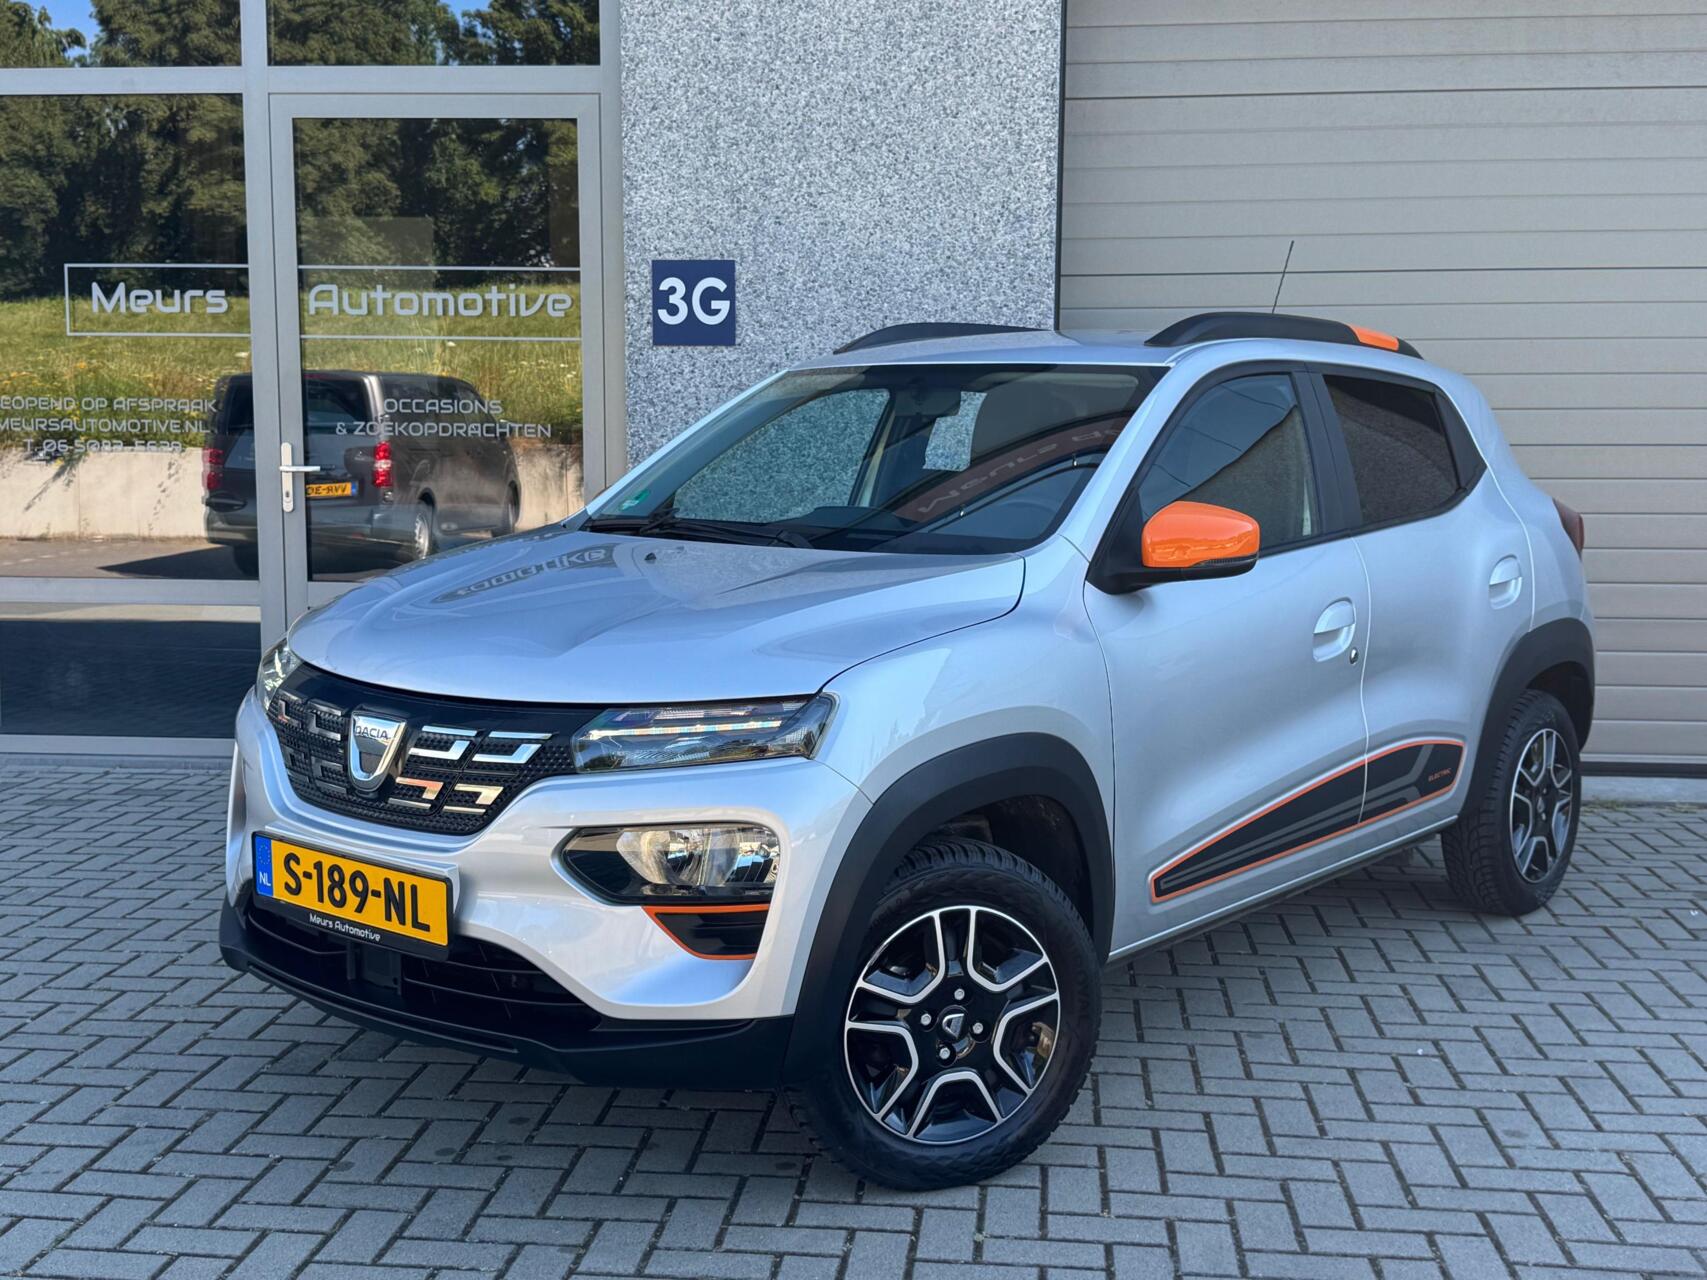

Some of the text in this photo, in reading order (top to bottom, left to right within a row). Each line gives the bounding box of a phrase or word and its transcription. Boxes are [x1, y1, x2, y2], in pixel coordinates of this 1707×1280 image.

[91, 281, 573, 318] Meurs Automotive
[656, 276, 731, 326] 3G
[81, 397, 108, 411] OP
[113, 397, 217, 412] AFSPRAAK
[383, 398, 504, 414] OCCASIONS
[335, 421, 552, 438] & ZOEKOPDRACHTEN
[355, 725, 389, 741] DACIA
[259, 871, 271, 887] NL
[283, 852, 431, 933] S-189-NL
[309, 912, 381, 942] Meurs Automotive
